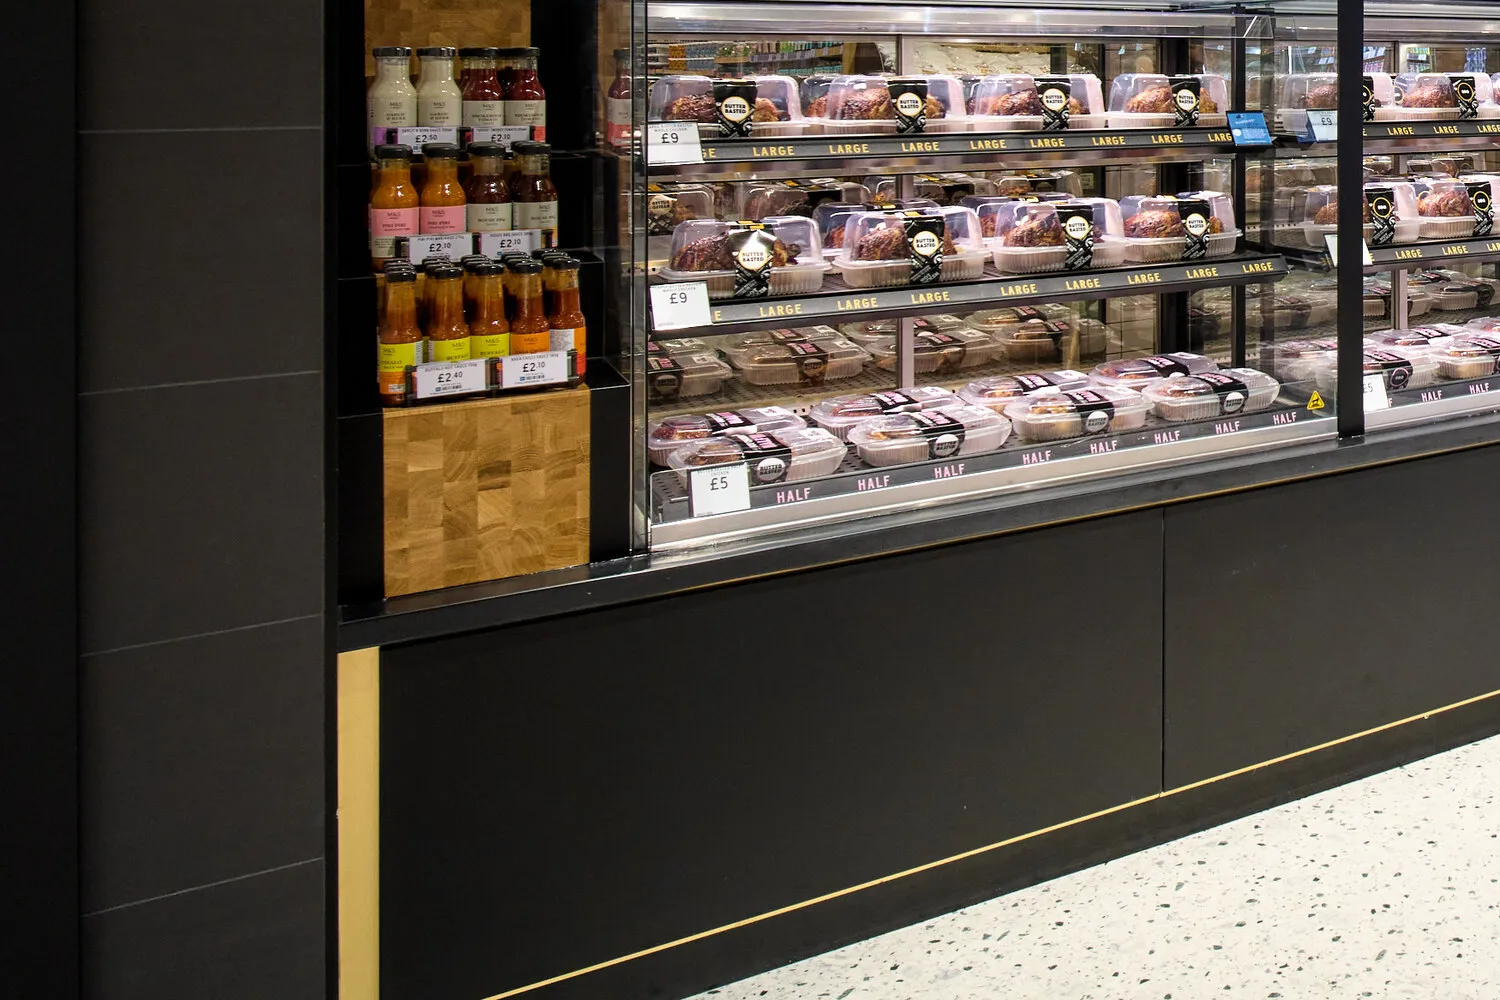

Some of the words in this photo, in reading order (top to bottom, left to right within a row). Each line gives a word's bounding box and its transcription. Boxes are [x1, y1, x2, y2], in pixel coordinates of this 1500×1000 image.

[1321, 117, 1333, 126] £9
[1387, 127, 1414, 136] LARGE
[1433, 125, 1460, 134] LARGE
[661, 132, 679, 144] £9
[753, 146, 794, 157] LARGE
[829, 143, 870, 154] LARGE
[902, 141, 940, 152] LARGE
[970, 139, 1006, 149] LARGE
[1030, 138, 1066, 148] LARGE
[1092, 135, 1126, 146] LARGE
[1151, 134, 1184, 144] LARGE
[1207, 132, 1232, 142] LARG
[429, 242, 452, 253] £2.10
[500, 238, 521, 248] £2.10
[1395, 249, 1423, 259] LARGE
[1442, 245, 1469, 256] LARGE
[760, 303, 802, 317] LARGE
[837, 297, 878, 311] LARGE
[911, 291, 950, 305] LARGE
[1001, 283, 1038, 296] LARGE
[1066, 278, 1100, 291] LARGE
[1127, 272, 1161, 285] LARGE
[1186, 267, 1219, 279] LARGE
[1242, 261, 1274, 274] LARGE
[669, 292, 688, 304] £9
[522, 361, 546, 373] £2.10
[437, 371, 463, 383] £2.40
[1421, 390, 1443, 402] HALF
[1469, 382, 1490, 394] HALF
[777, 487, 811, 504] HALF
[858, 475, 890, 491] HALF
[934, 463, 965, 479] HALF
[1022, 450, 1051, 465] HALF
[1090, 440, 1117, 454] HALF
[1154, 430, 1181, 444] HALF
[1215, 421, 1240, 434] HALF
[1273, 411, 1297, 425] HALF
[710, 476, 729, 491] £5
